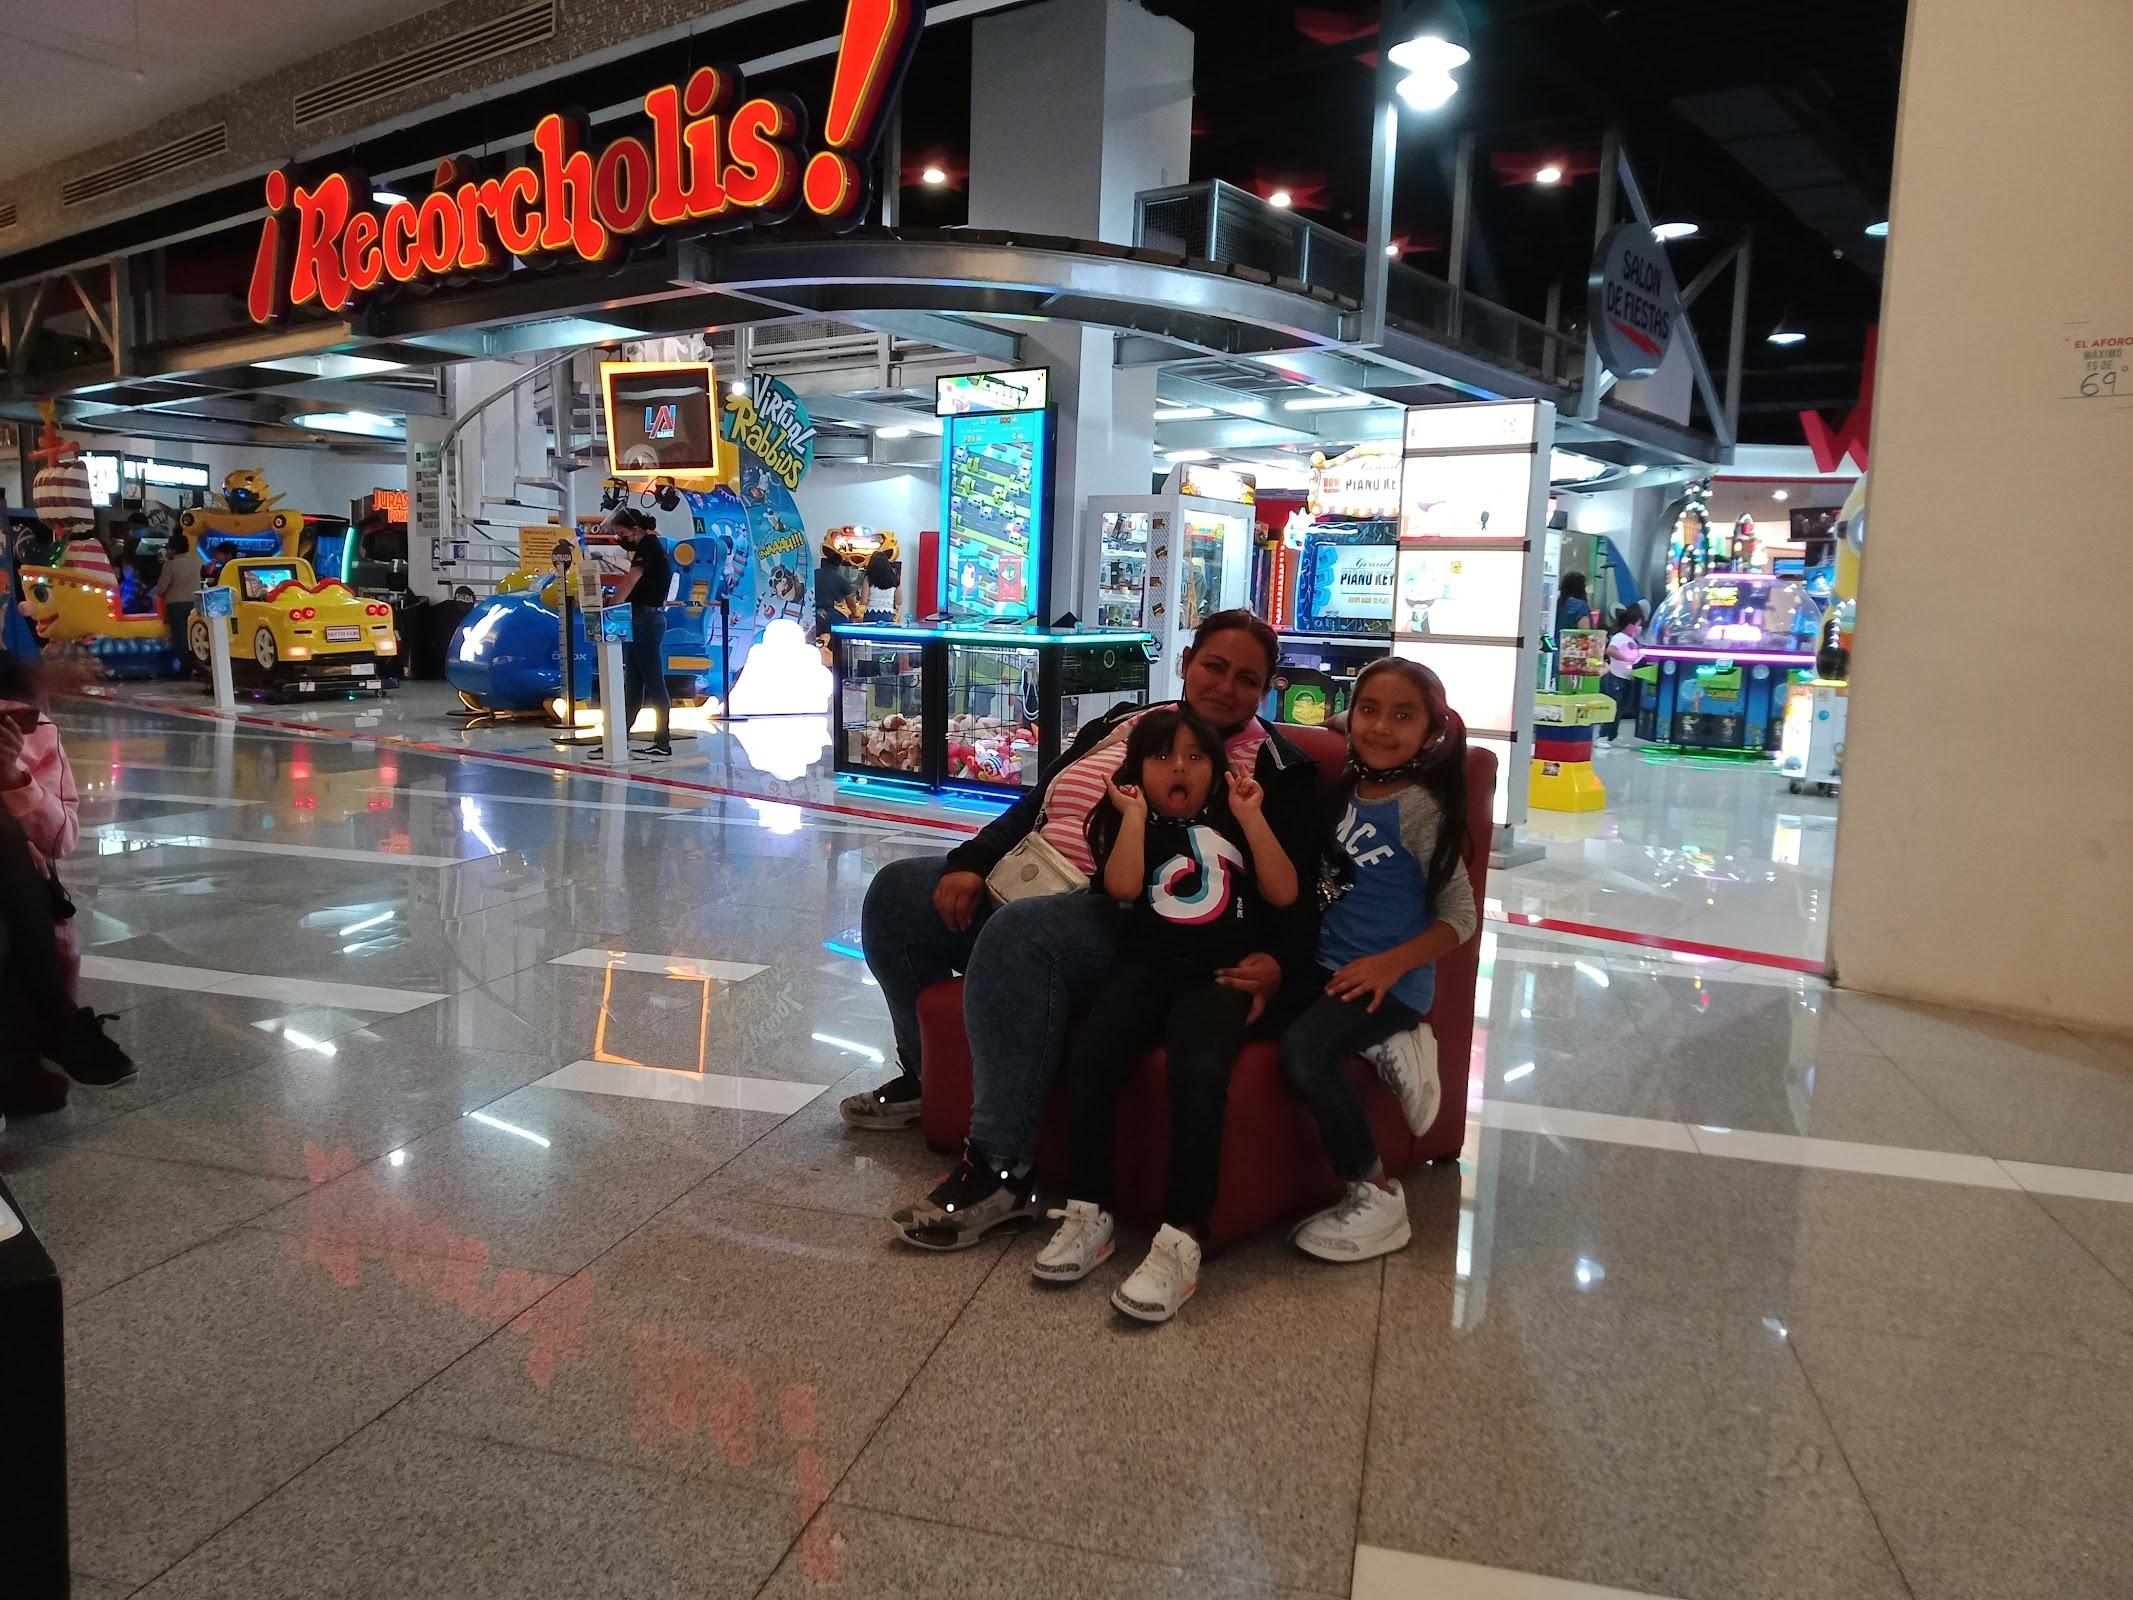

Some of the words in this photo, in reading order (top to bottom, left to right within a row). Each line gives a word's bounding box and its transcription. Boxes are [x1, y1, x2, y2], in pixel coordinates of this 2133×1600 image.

[1623, 249, 1662, 296] SALON
[1607, 281, 1623, 316] DE
[1624, 291, 1669, 339] FIESTAS
[2075, 340, 2088, 348] EL
[2091, 336, 2133, 348] AFORO
[2080, 371, 2116, 396] 69
[1340, 572, 1373, 586] PIANO
